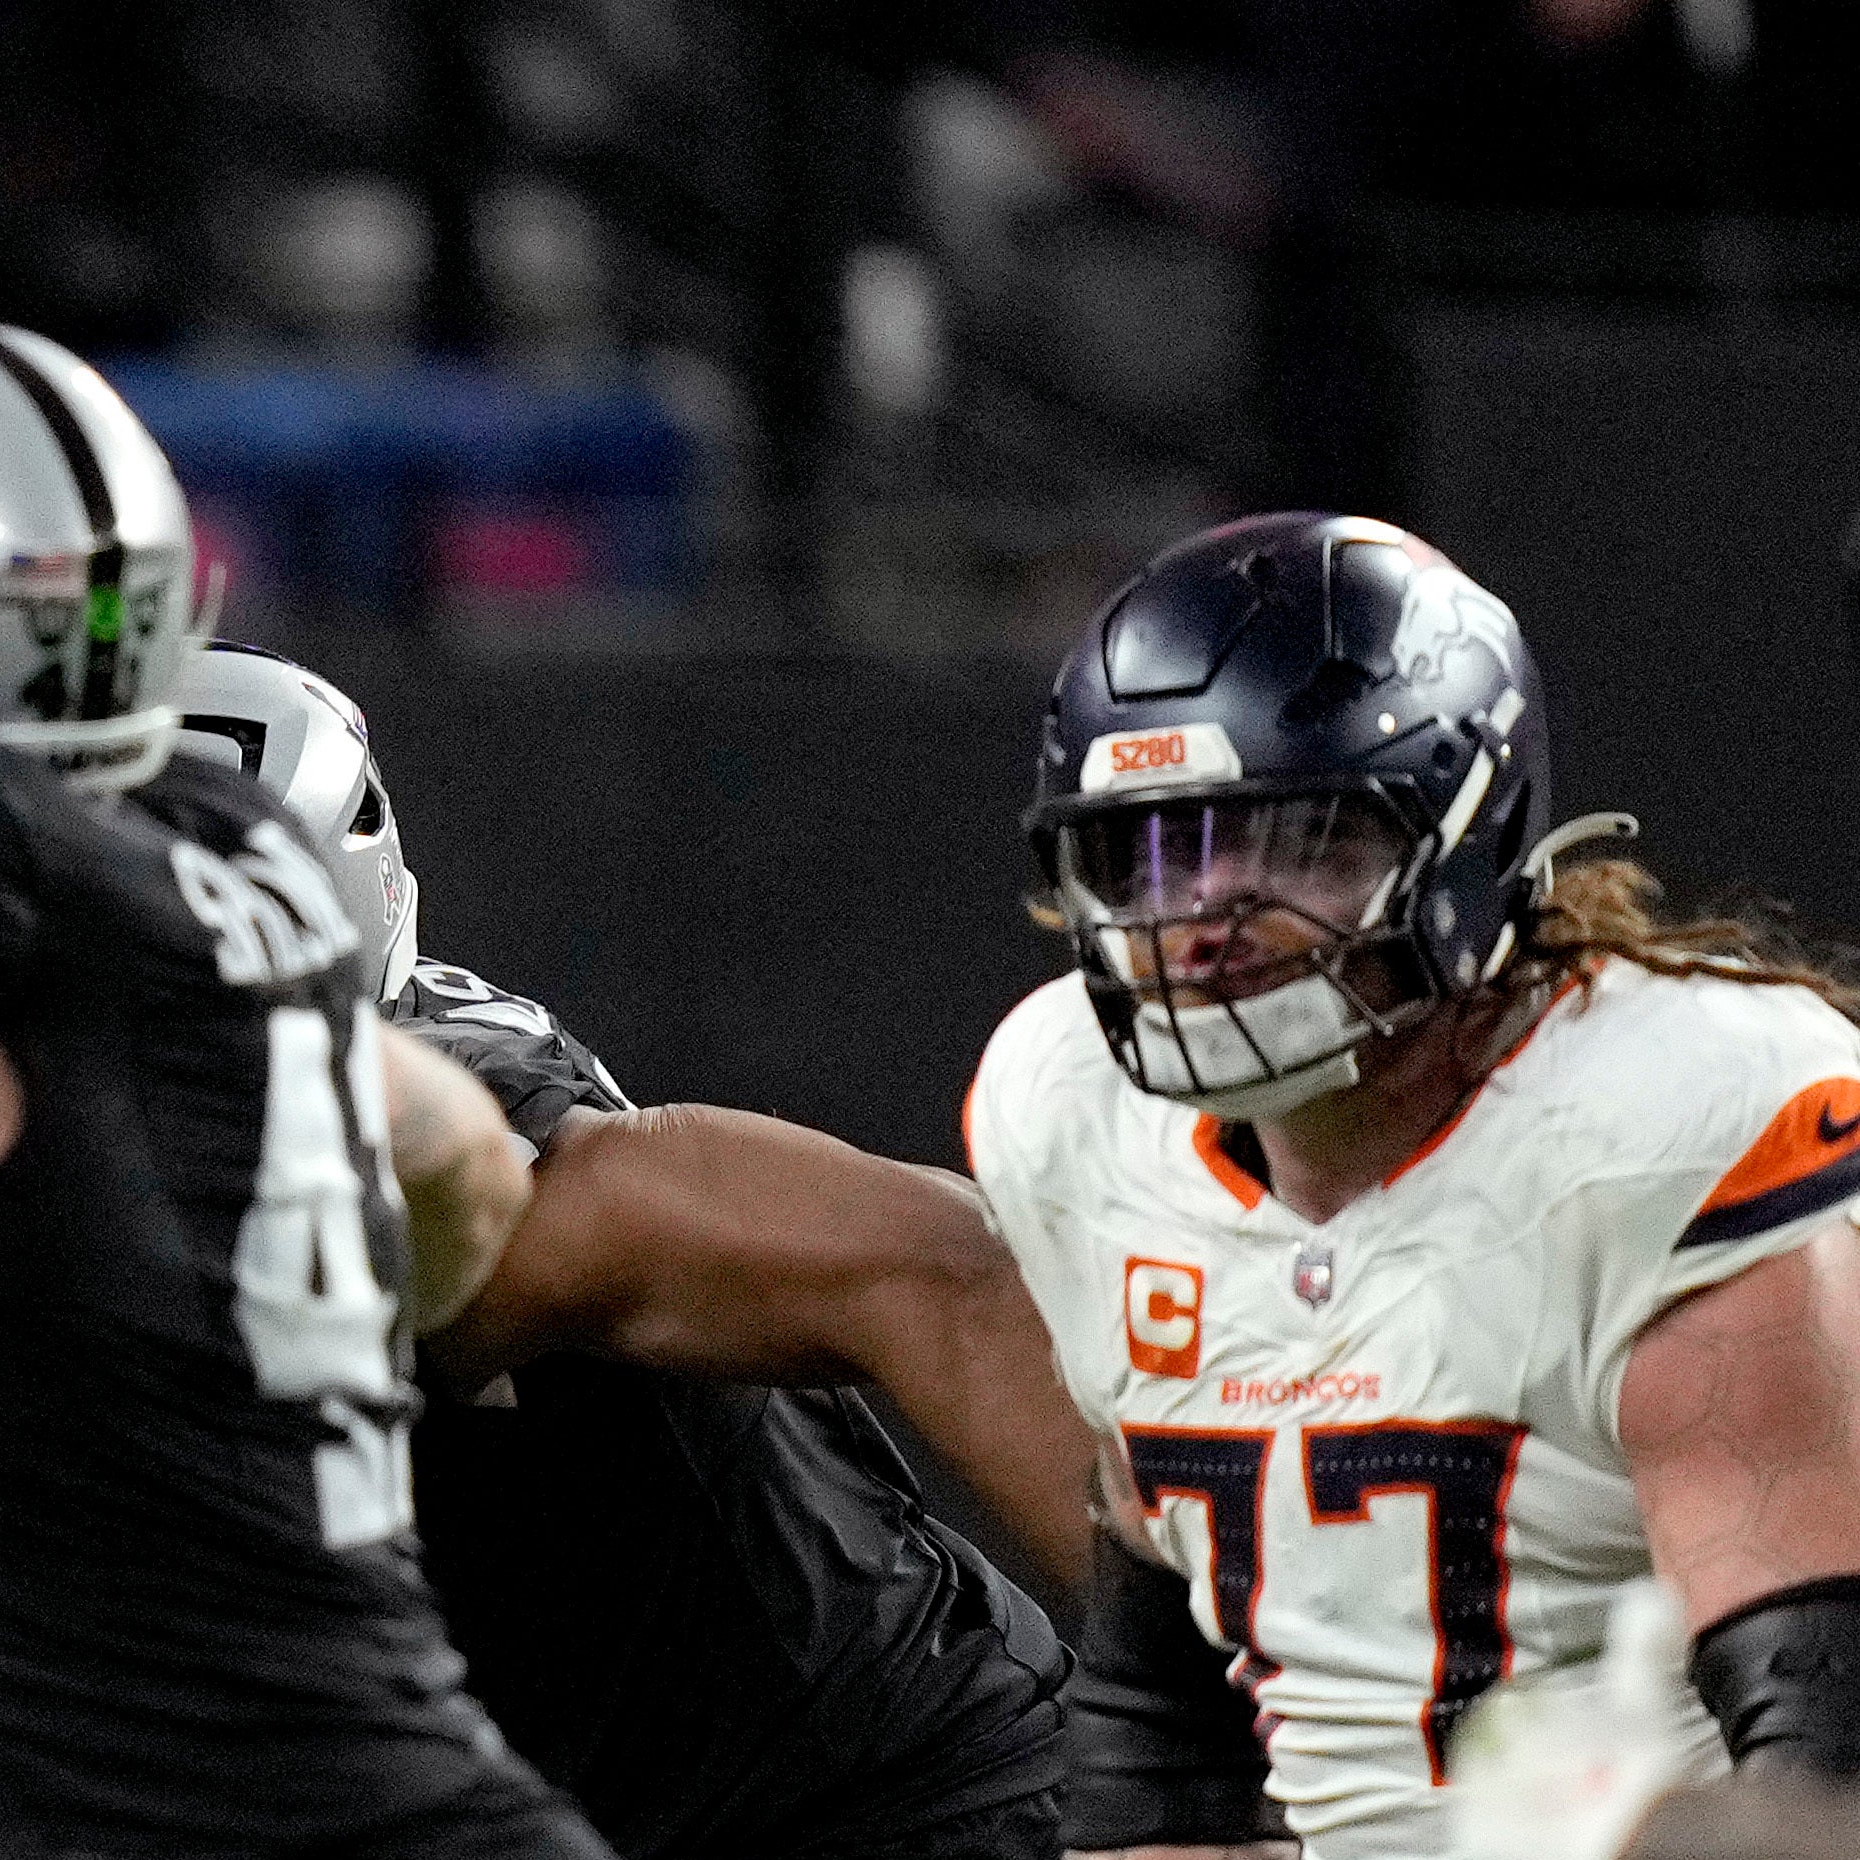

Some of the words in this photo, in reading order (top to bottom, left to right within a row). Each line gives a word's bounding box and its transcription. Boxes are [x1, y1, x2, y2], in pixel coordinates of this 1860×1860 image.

[1112, 734, 1185, 772] 5280
[1130, 1264, 1199, 1352] C
[1220, 1371, 1381, 1406] BRONCOS
[1119, 1416, 1531, 1788] 77
